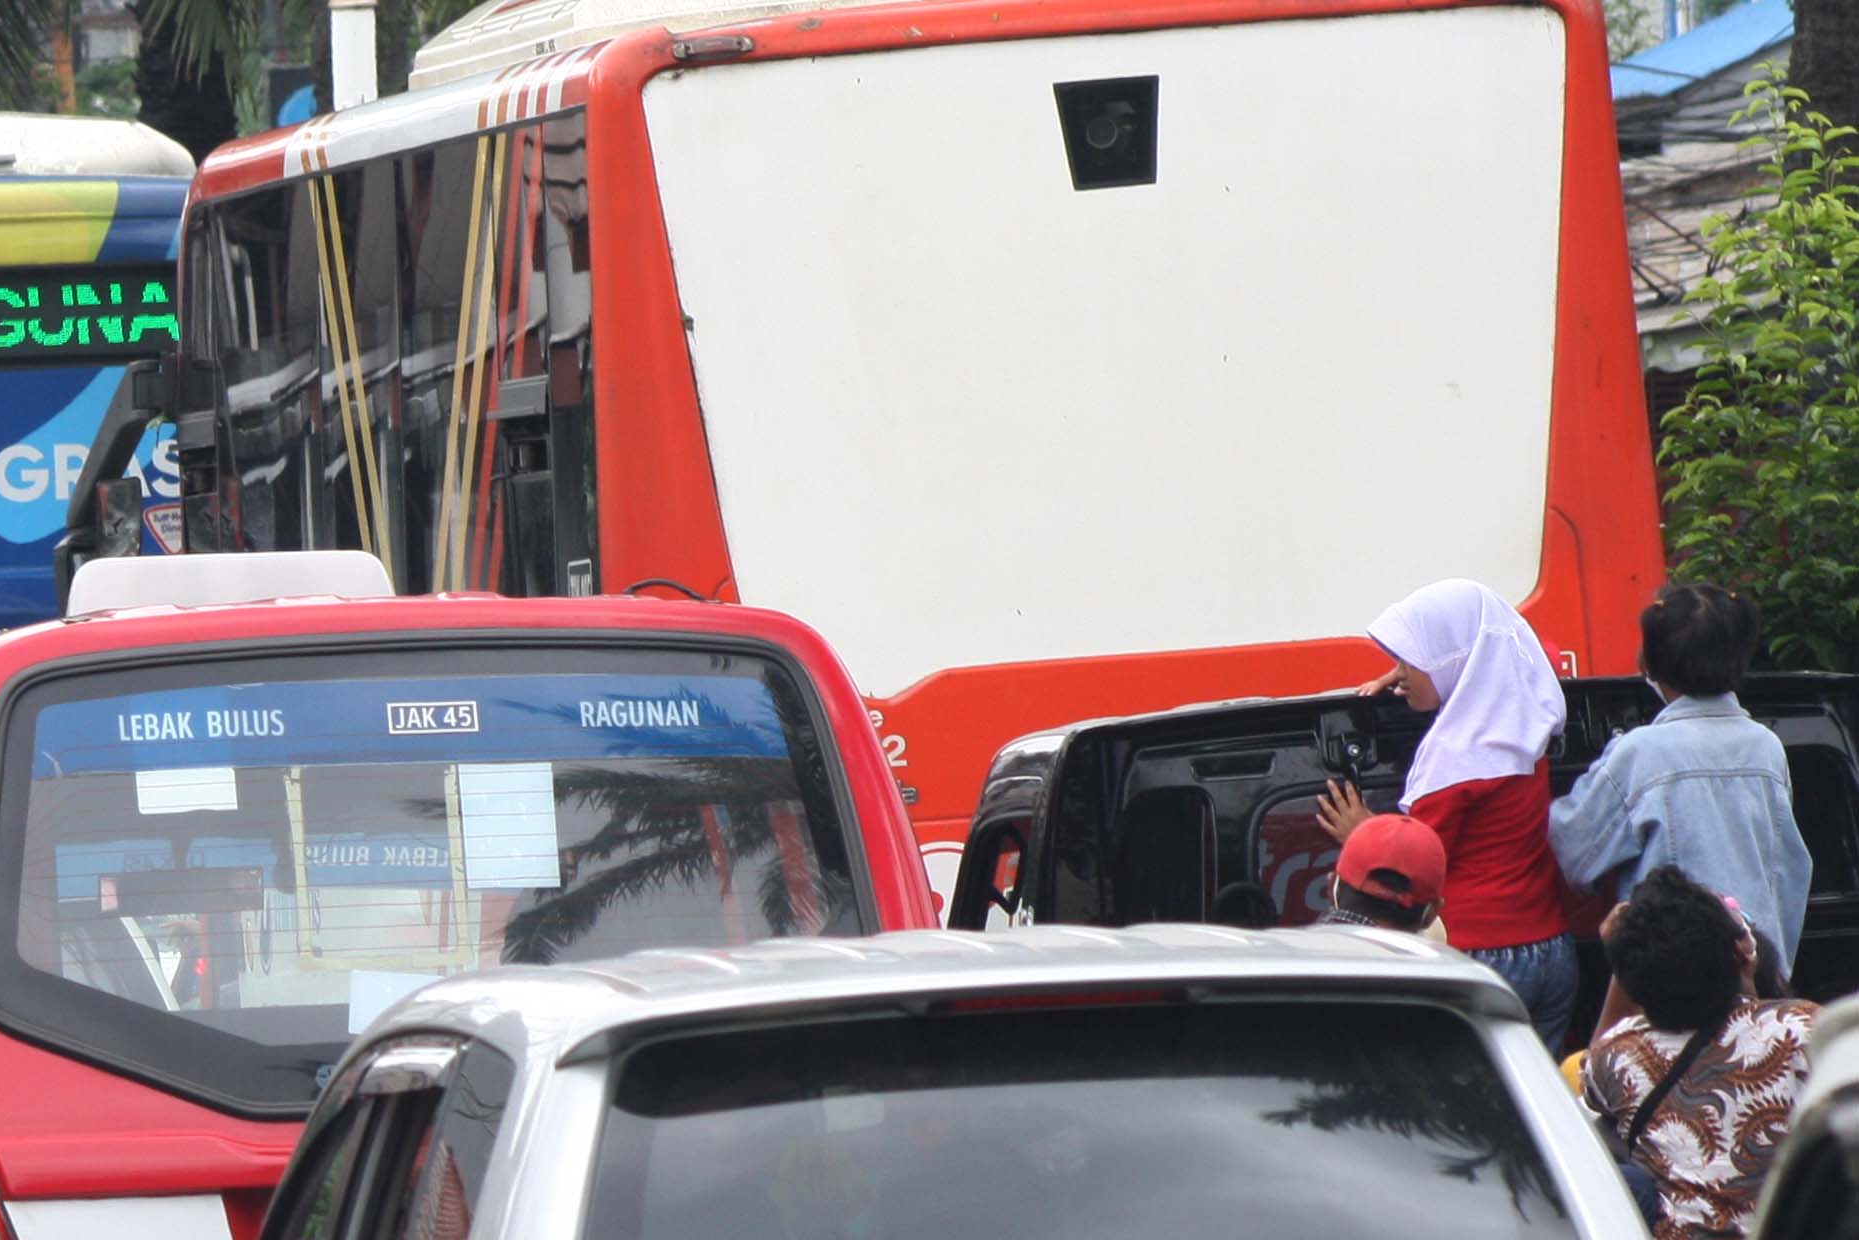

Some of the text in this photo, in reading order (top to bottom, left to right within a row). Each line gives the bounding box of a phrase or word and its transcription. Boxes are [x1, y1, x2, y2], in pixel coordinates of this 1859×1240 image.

[118, 700, 700, 741] LEBAK BULUS JAK 45 RAGUNAN
